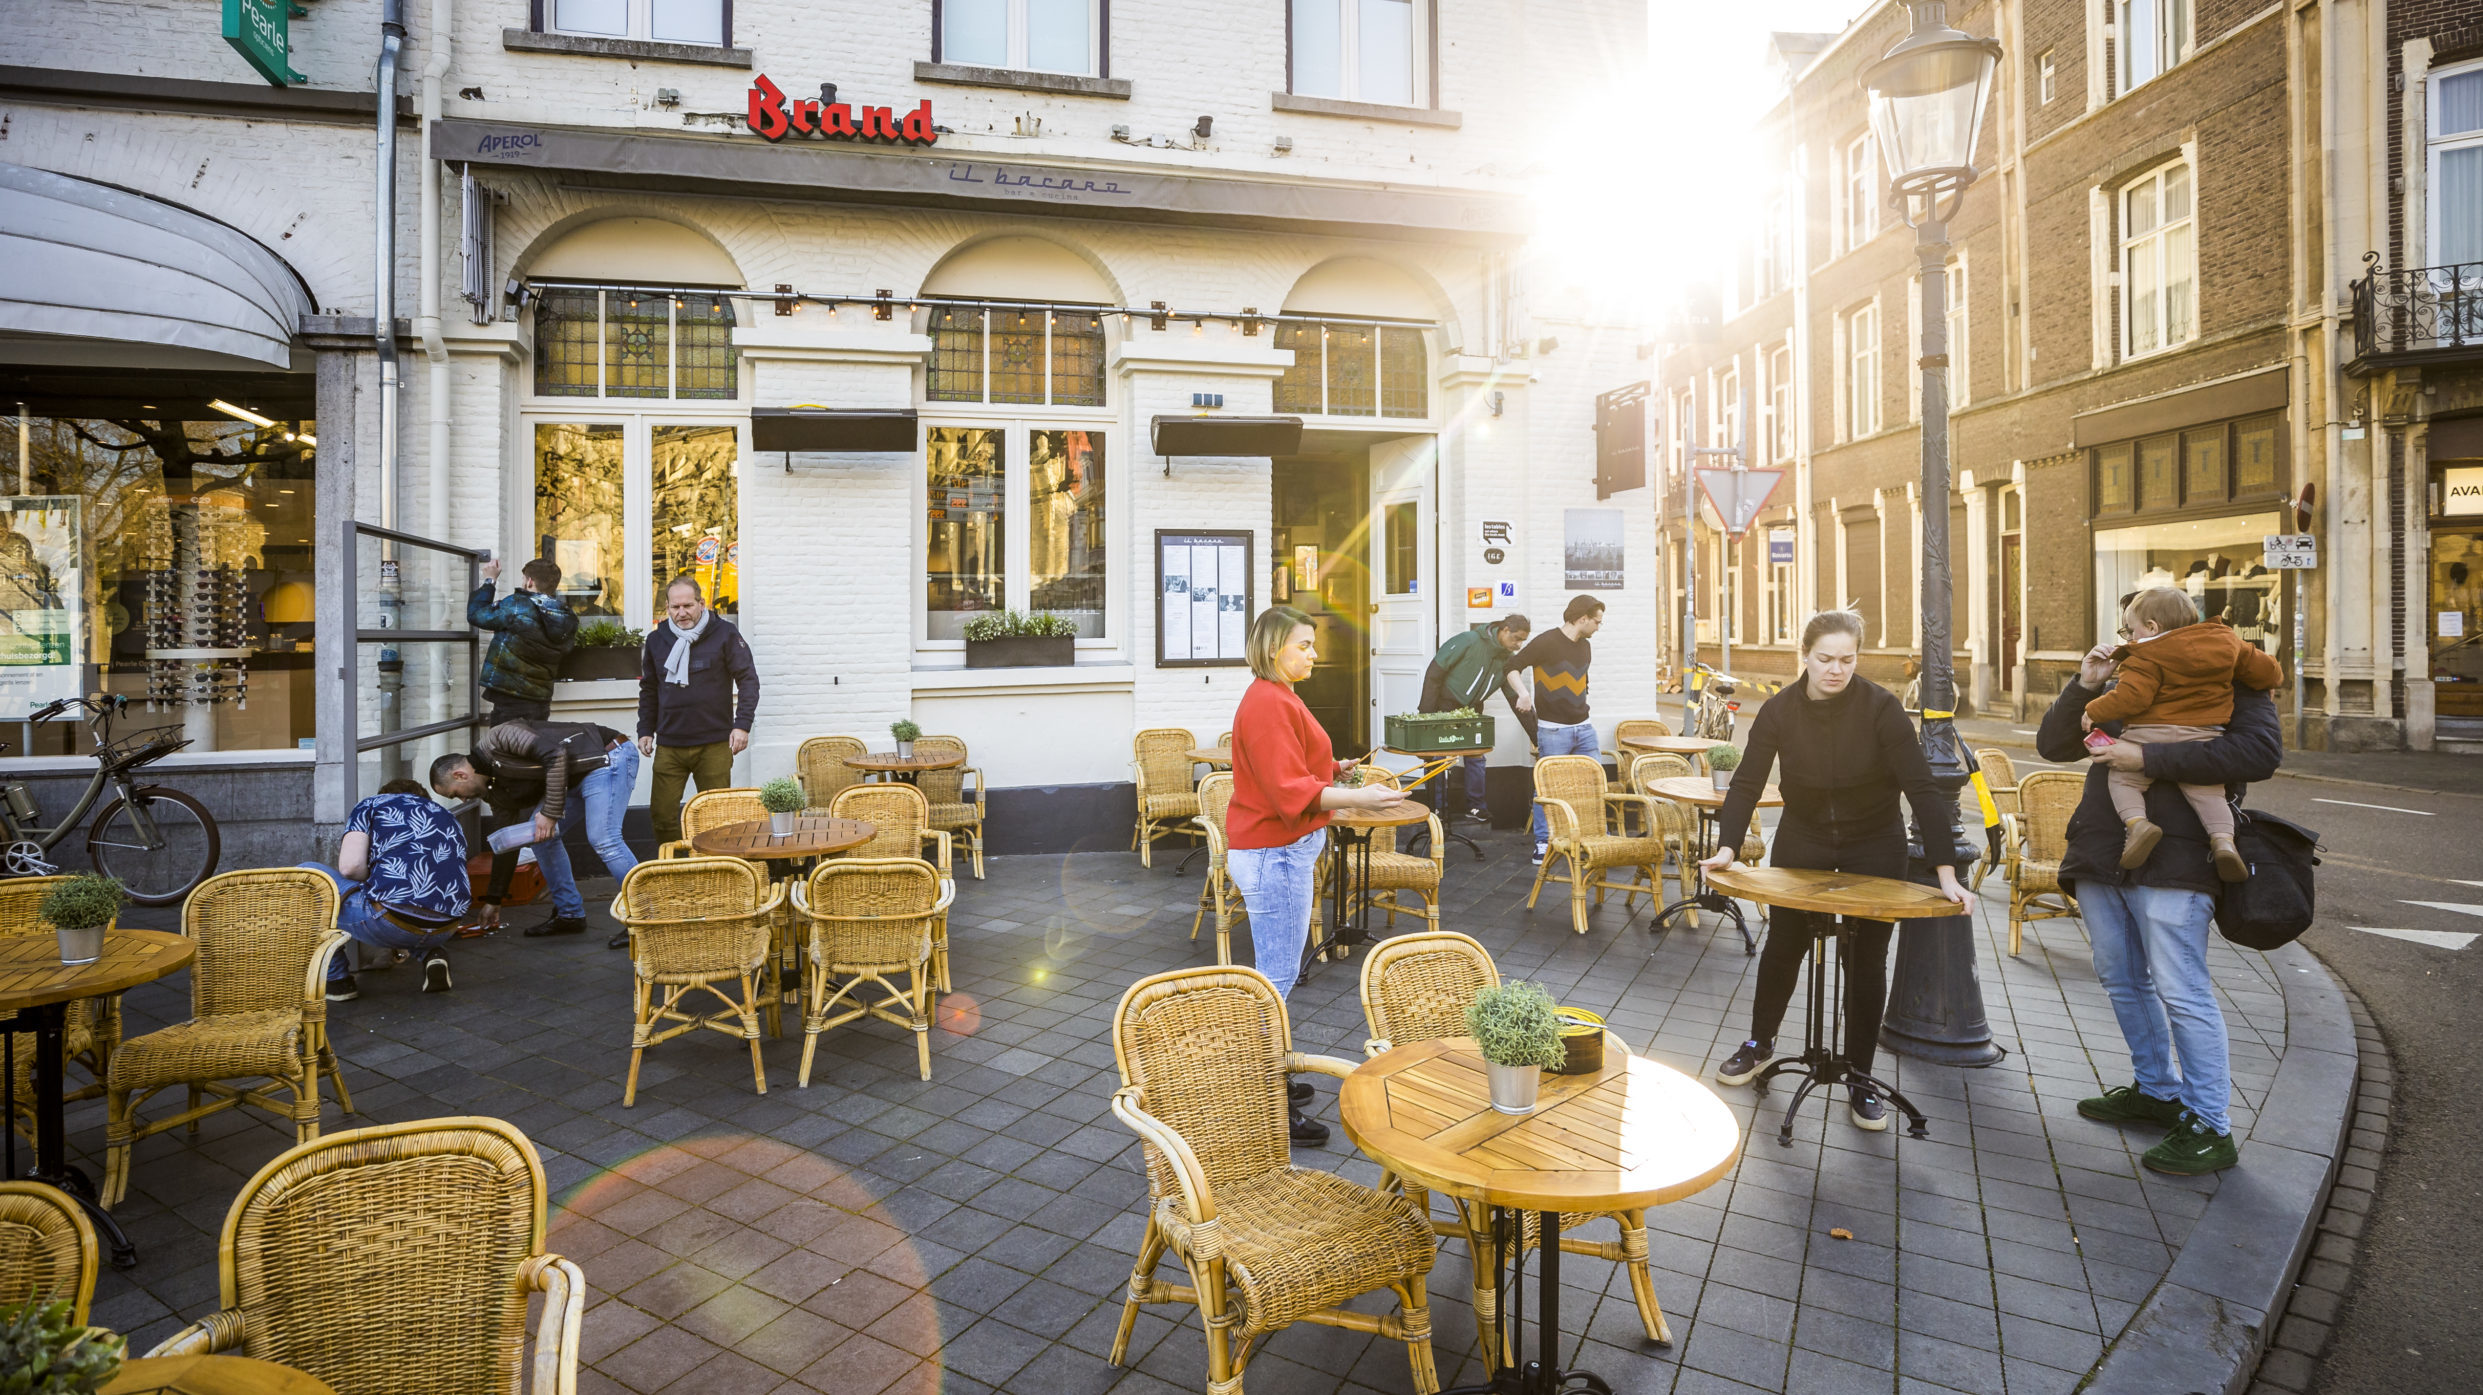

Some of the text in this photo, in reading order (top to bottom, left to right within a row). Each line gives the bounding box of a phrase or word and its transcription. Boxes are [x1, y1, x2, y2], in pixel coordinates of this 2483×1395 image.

[747, 73, 938, 147] Brand
[477, 133, 542, 153] APEROL
[500, 150, 520, 160] 1919
[949, 163, 1132, 194] il bacaro
[2450, 485, 2483, 497] AVA
